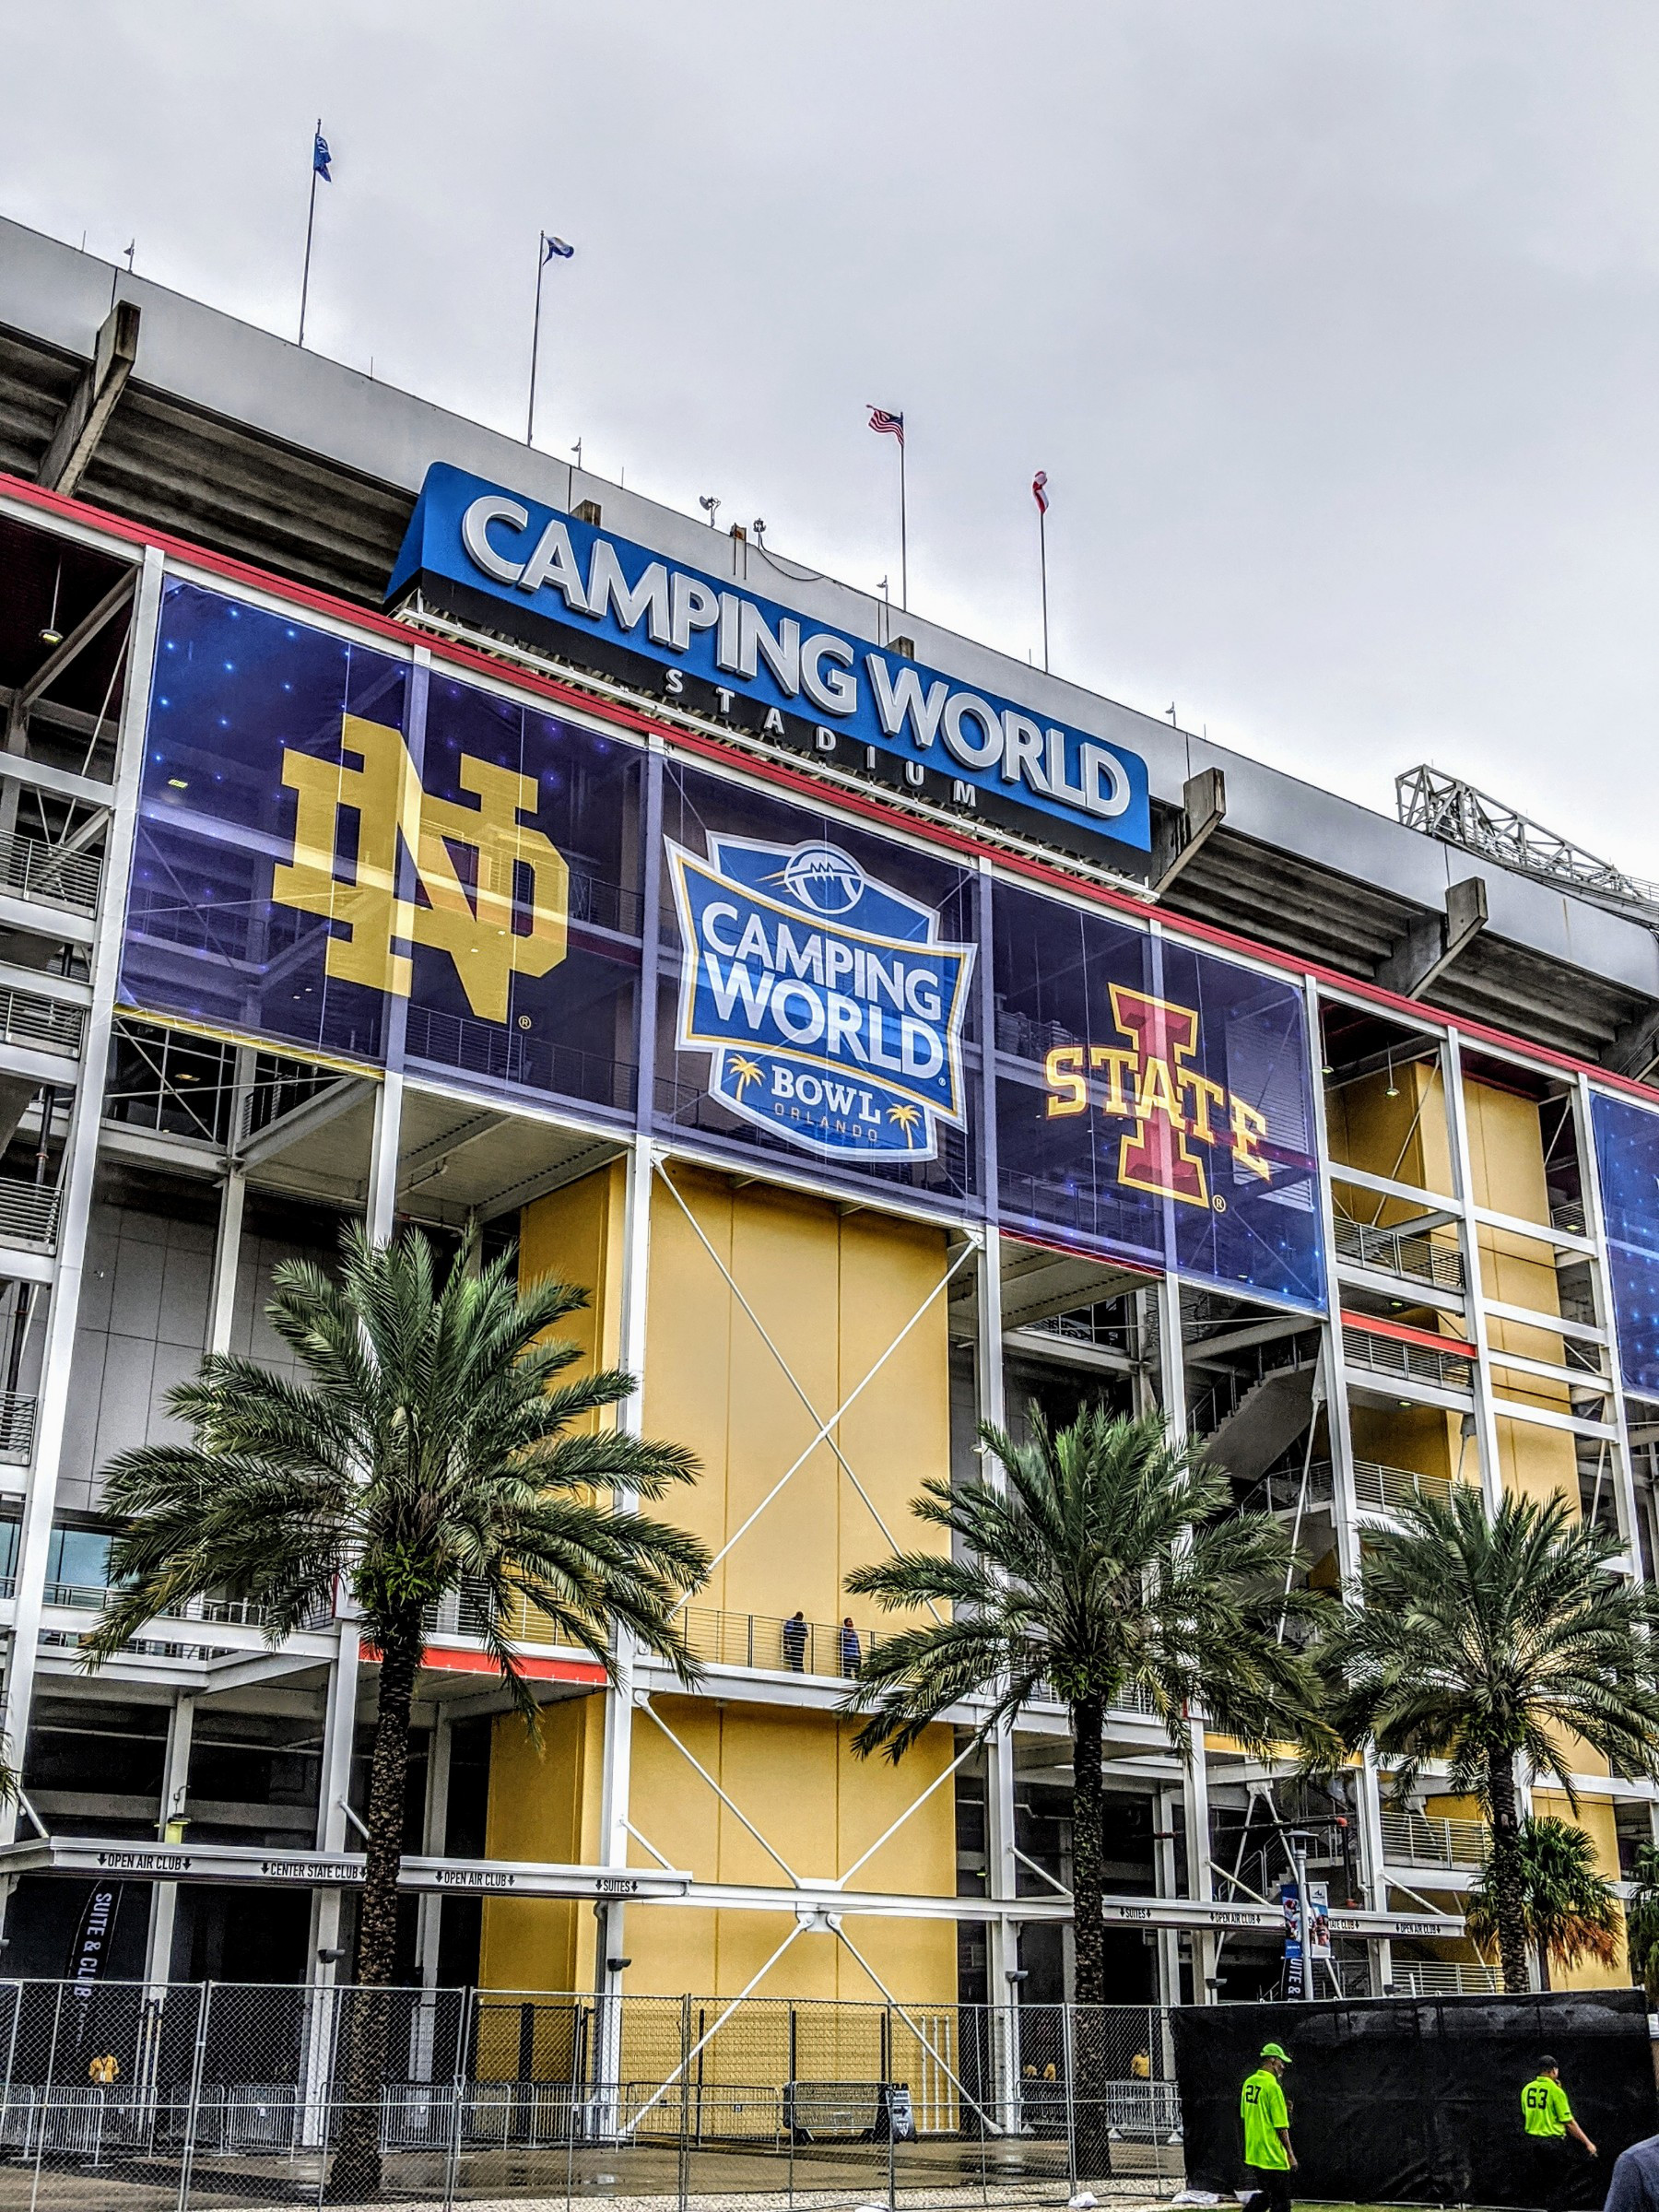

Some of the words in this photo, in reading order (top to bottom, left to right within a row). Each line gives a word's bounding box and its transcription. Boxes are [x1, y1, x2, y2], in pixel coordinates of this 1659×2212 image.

[463, 494, 858, 716] CAMPING
[865, 653, 1131, 818] WORLD
[665, 667, 977, 808] STADIUM
[701, 901, 942, 1021] CAMPING
[702, 950, 945, 1080] WORLD
[771, 1065, 881, 1124] BOWL
[774, 1104, 878, 1142] ORLANDO
[1044, 1043, 1273, 1185] STATE
[108, 1853, 135, 1868] OPEN
[136, 1854, 154, 1869] AIR
[156, 1856, 182, 1870] CLUB
[270, 1863, 305, 1877] CENTER
[307, 1864, 333, 1878] STATE
[335, 1865, 358, 1879] CLUB
[444, 1871, 465, 1885] OPEN
[468, 1872, 483, 1886] AIR
[485, 1873, 507, 1887] CLUB
[603, 1879, 630, 1892] SUITES
[87, 1892, 112, 1936] SUITE
[1125, 1908, 1146, 1919] SUITES
[1216, 1912, 1230, 1923] OPEN
[1230, 1913, 1241, 1924] AIR
[1241, 1914, 1256, 1924] CLUB
[1400, 1924, 1413, 1933] OPEN
[1424, 1925, 1436, 1935] CLUB
[83, 1940, 101, 1952] &
[1288, 1958, 1303, 1984] UITE
[1288, 1985, 1301, 1995] &
[1246, 2085, 1262, 2105] 27
[1527, 2088, 1548, 2110] 63
